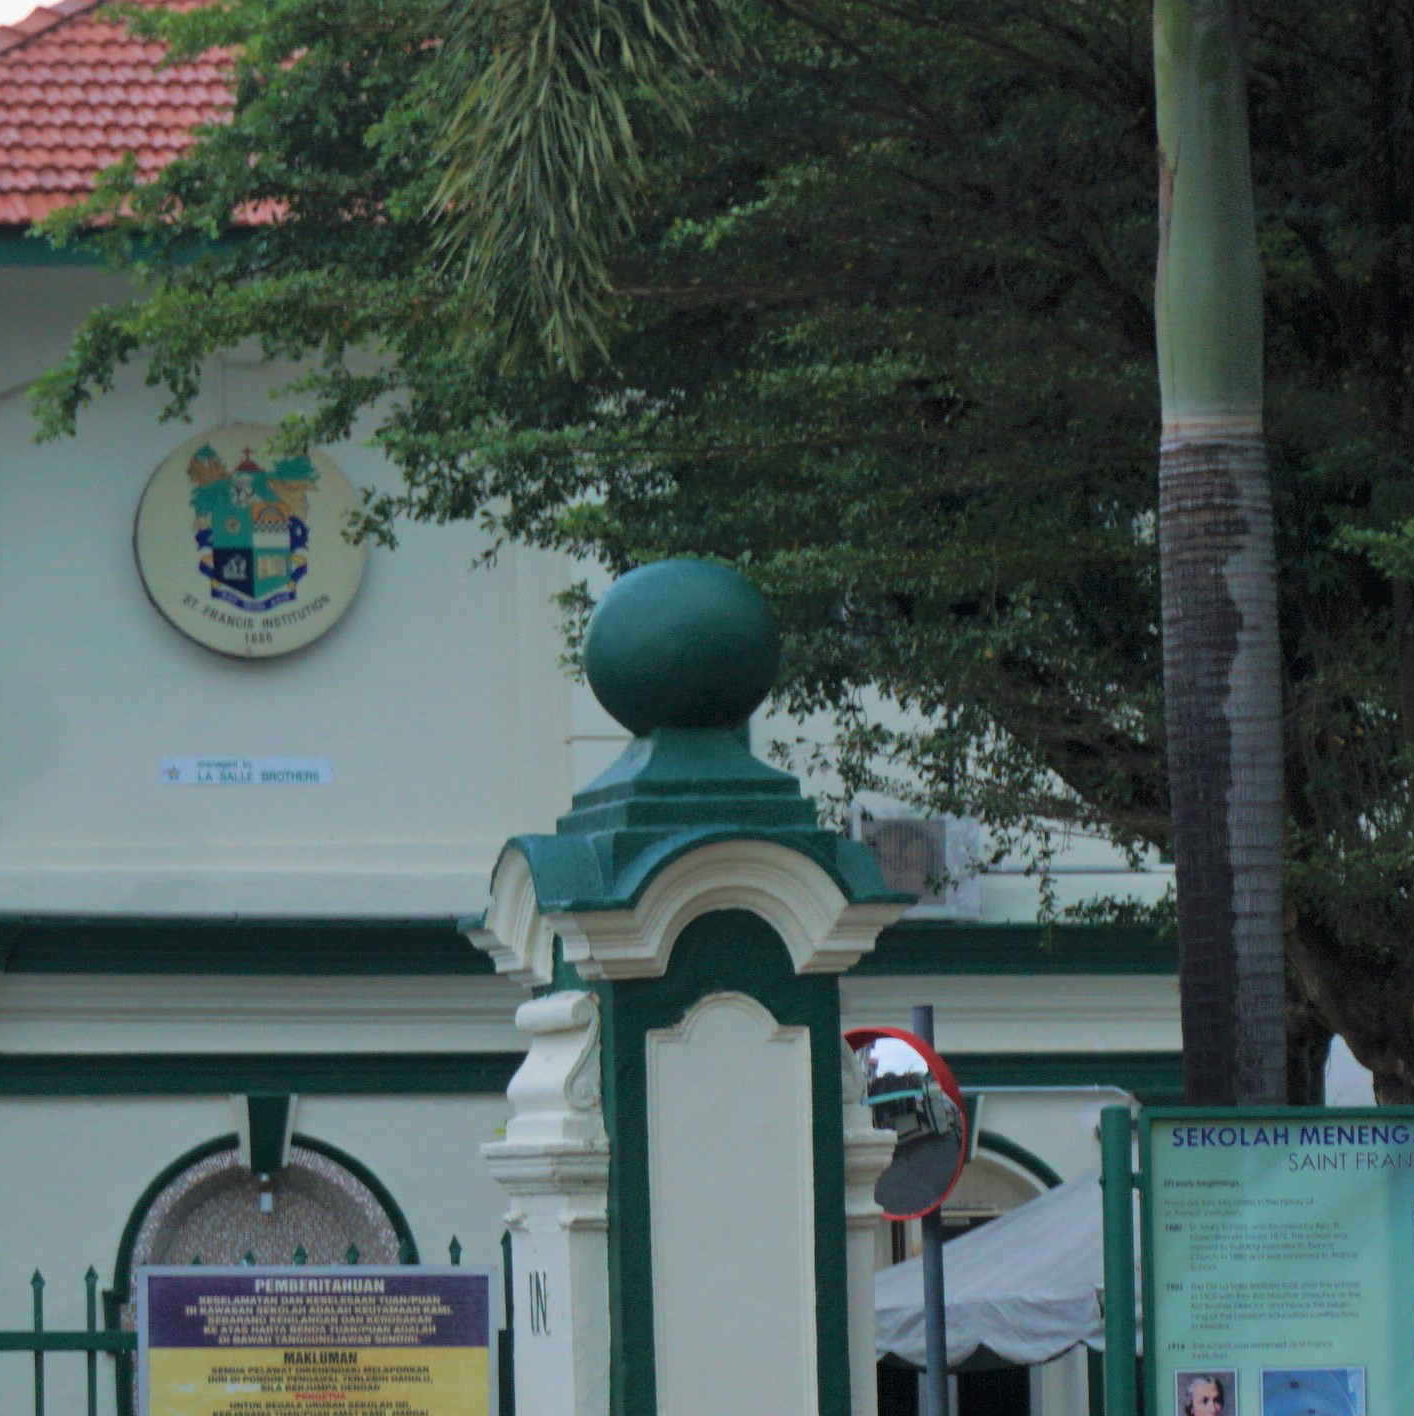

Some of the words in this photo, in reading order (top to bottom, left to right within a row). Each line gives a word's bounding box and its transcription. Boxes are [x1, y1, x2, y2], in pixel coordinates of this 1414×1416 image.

[203, 605, 254, 629] FRANCIS
[262, 592, 331, 629] INSTITUTION
[198, 771, 212, 781] LA
[220, 771, 252, 781] SALLE
[262, 770, 320, 782] BROTHERS
[1172, 1126, 1289, 1147] SEKOLAH
[1288, 1153, 1347, 1171] SAINT
[254, 1278, 385, 1293] PEMBERITAHUAN
[283, 1351, 358, 1365] MAKLUMAN
